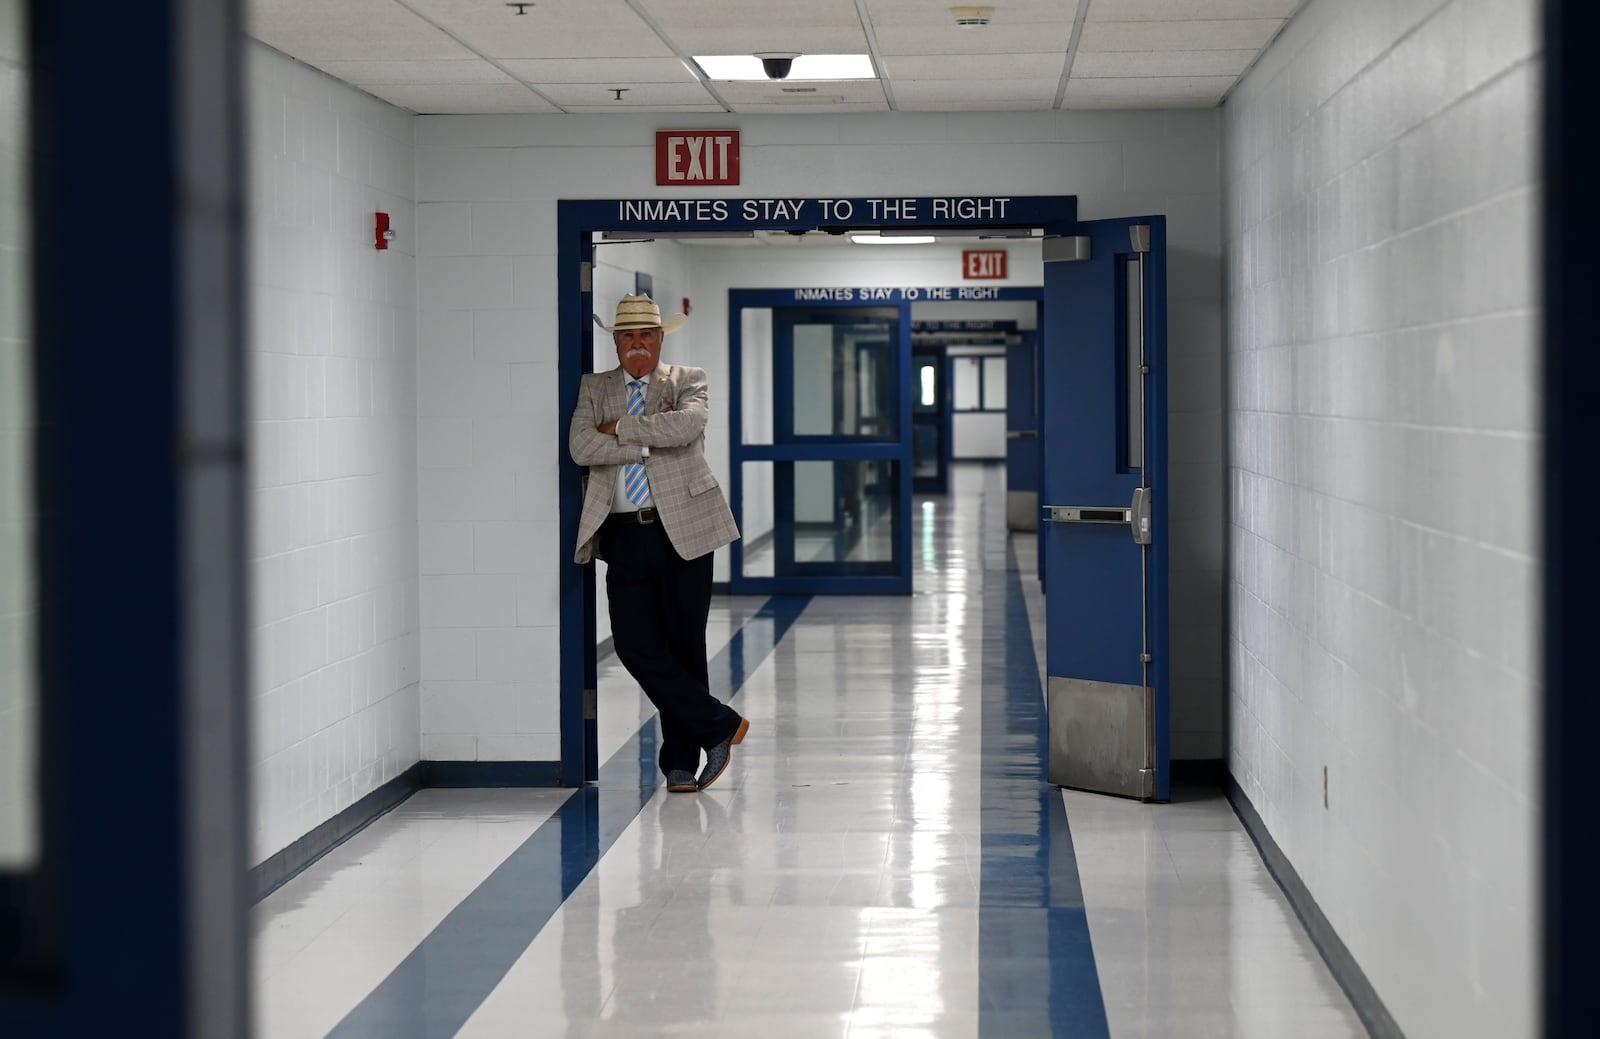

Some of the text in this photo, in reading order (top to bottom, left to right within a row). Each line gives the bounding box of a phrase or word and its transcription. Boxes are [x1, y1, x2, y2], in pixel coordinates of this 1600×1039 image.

[668, 136, 732, 180] EXIT
[619, 198, 1010, 221] INMATES STAY TO THE RIGHT
[968, 252, 1003, 276] EXIT
[795, 286, 999, 300] INMATES STAY TO THE RIGHT
